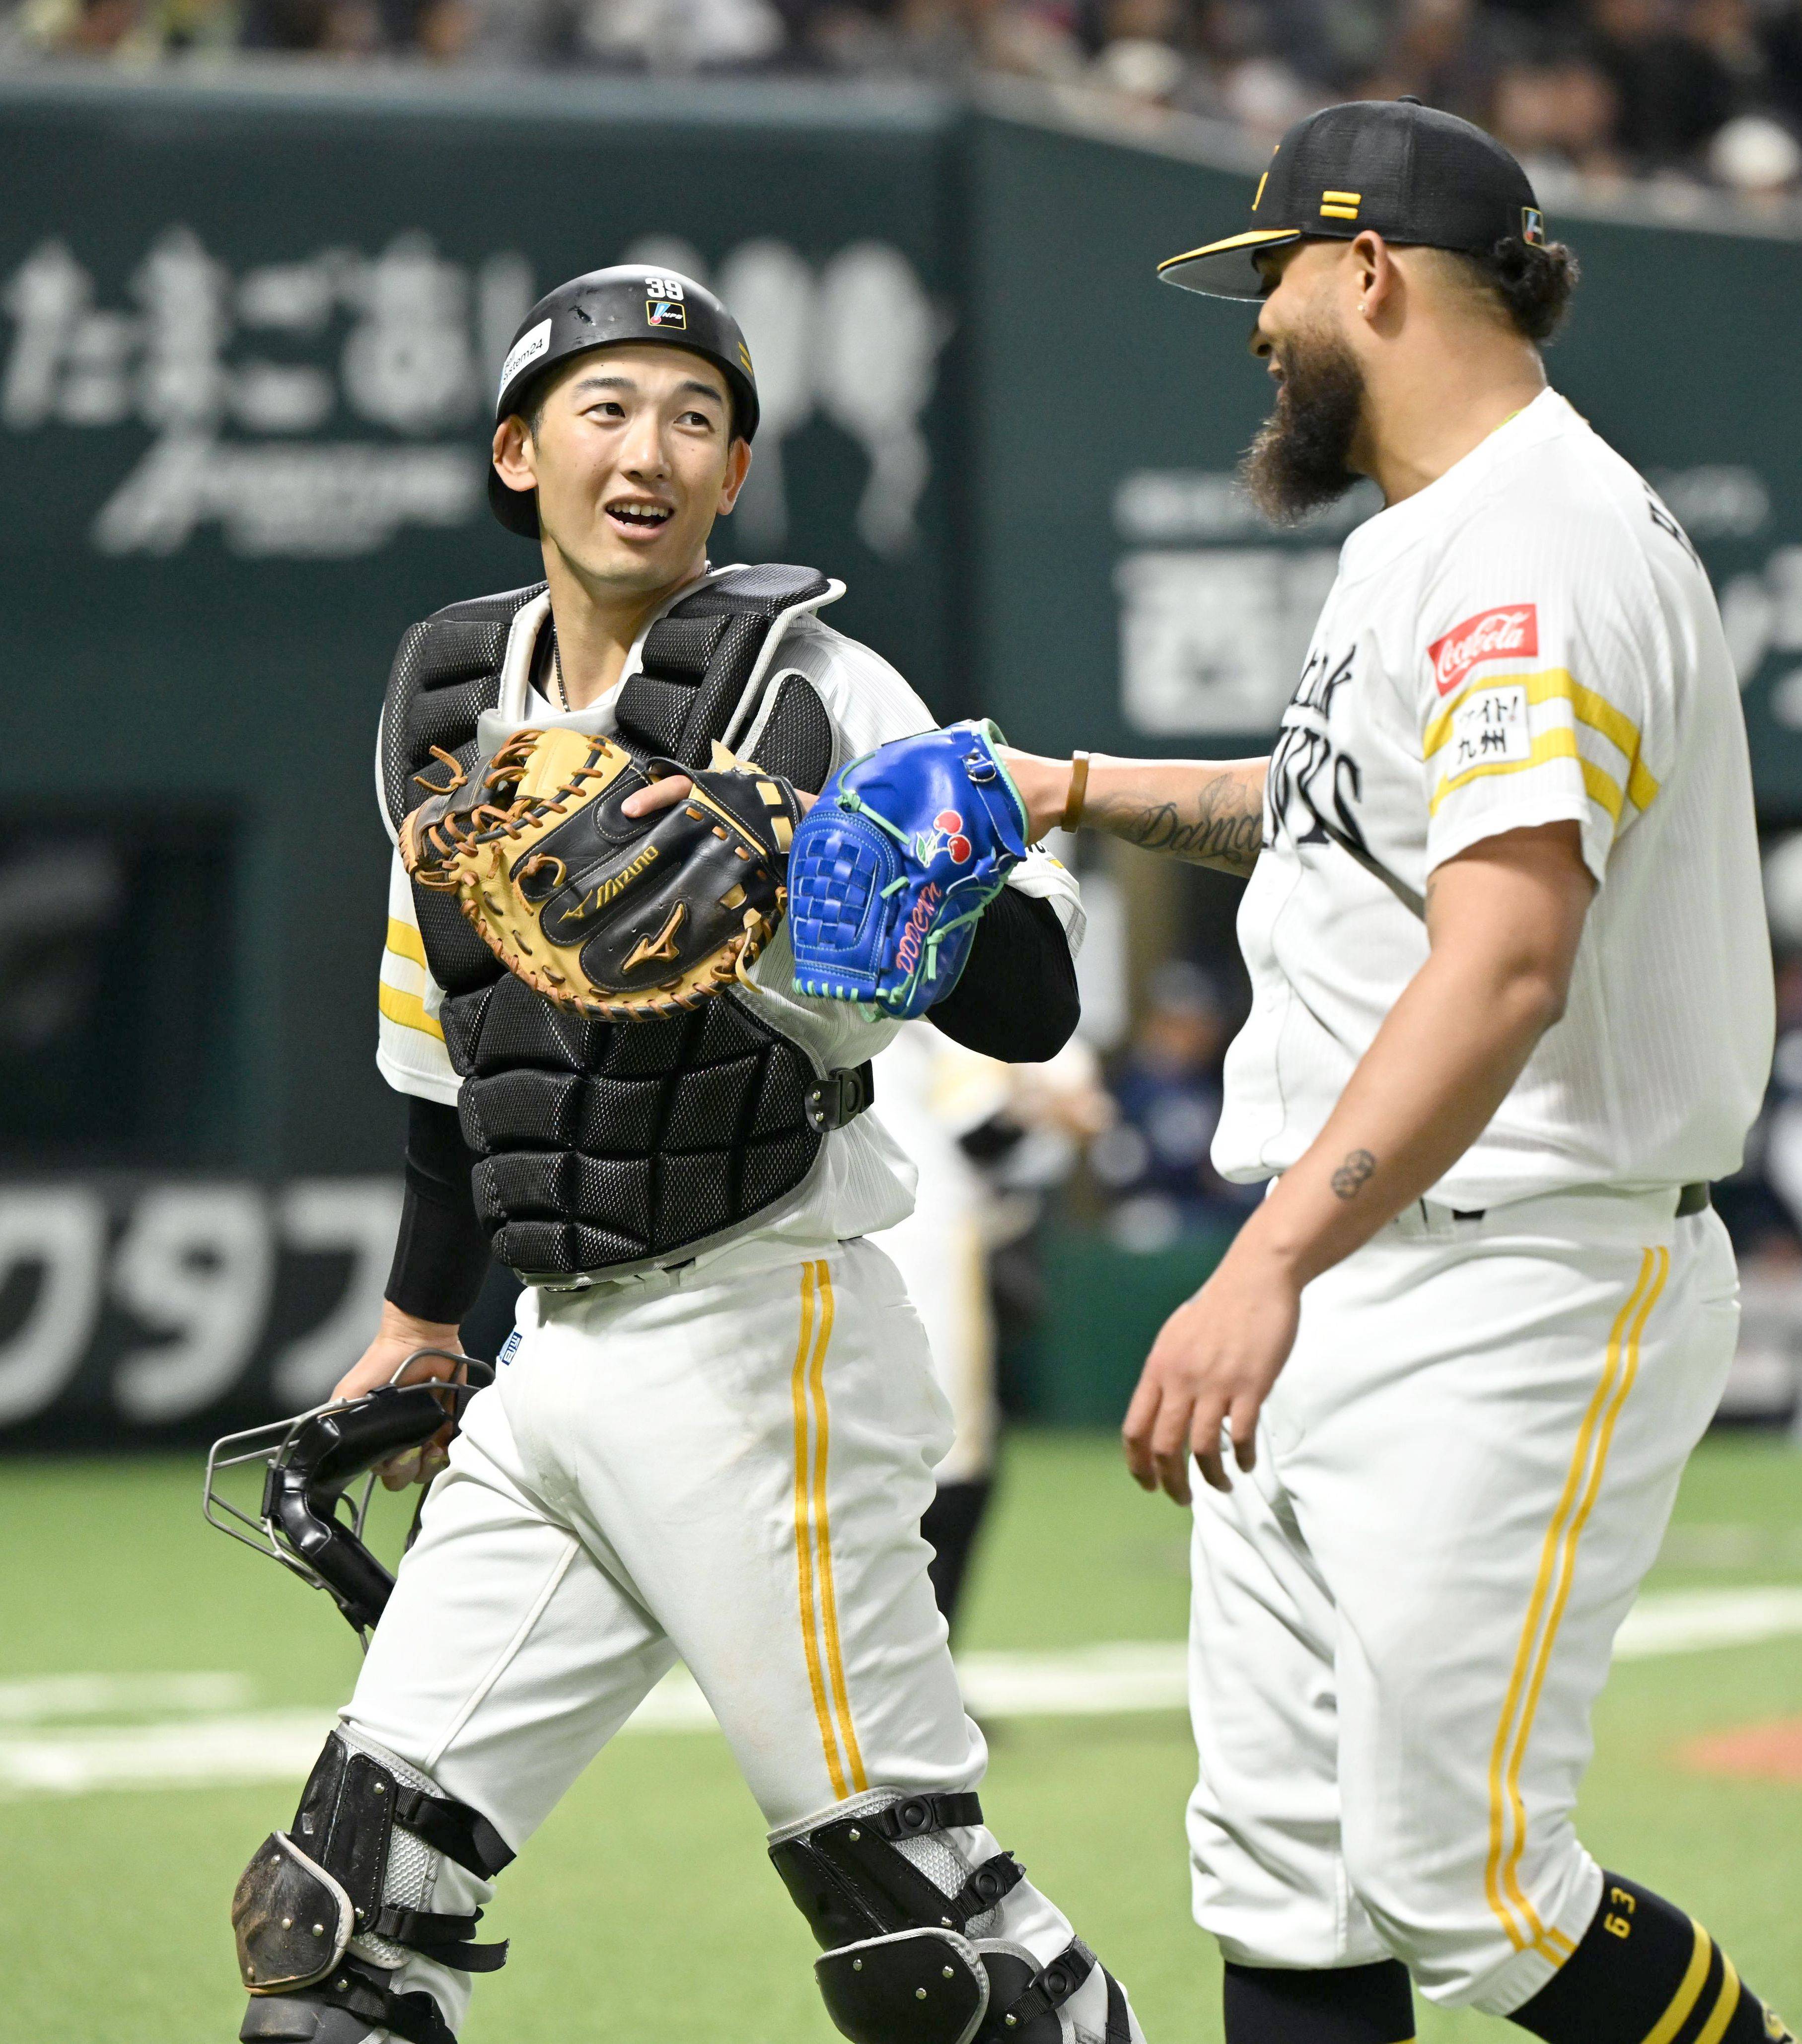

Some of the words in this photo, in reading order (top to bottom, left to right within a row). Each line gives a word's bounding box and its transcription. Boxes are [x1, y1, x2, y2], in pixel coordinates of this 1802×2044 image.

[645, 278, 684, 301] 39
[1458, 728, 1507, 765] 九州
[1603, 1887, 1636, 1939] 63
